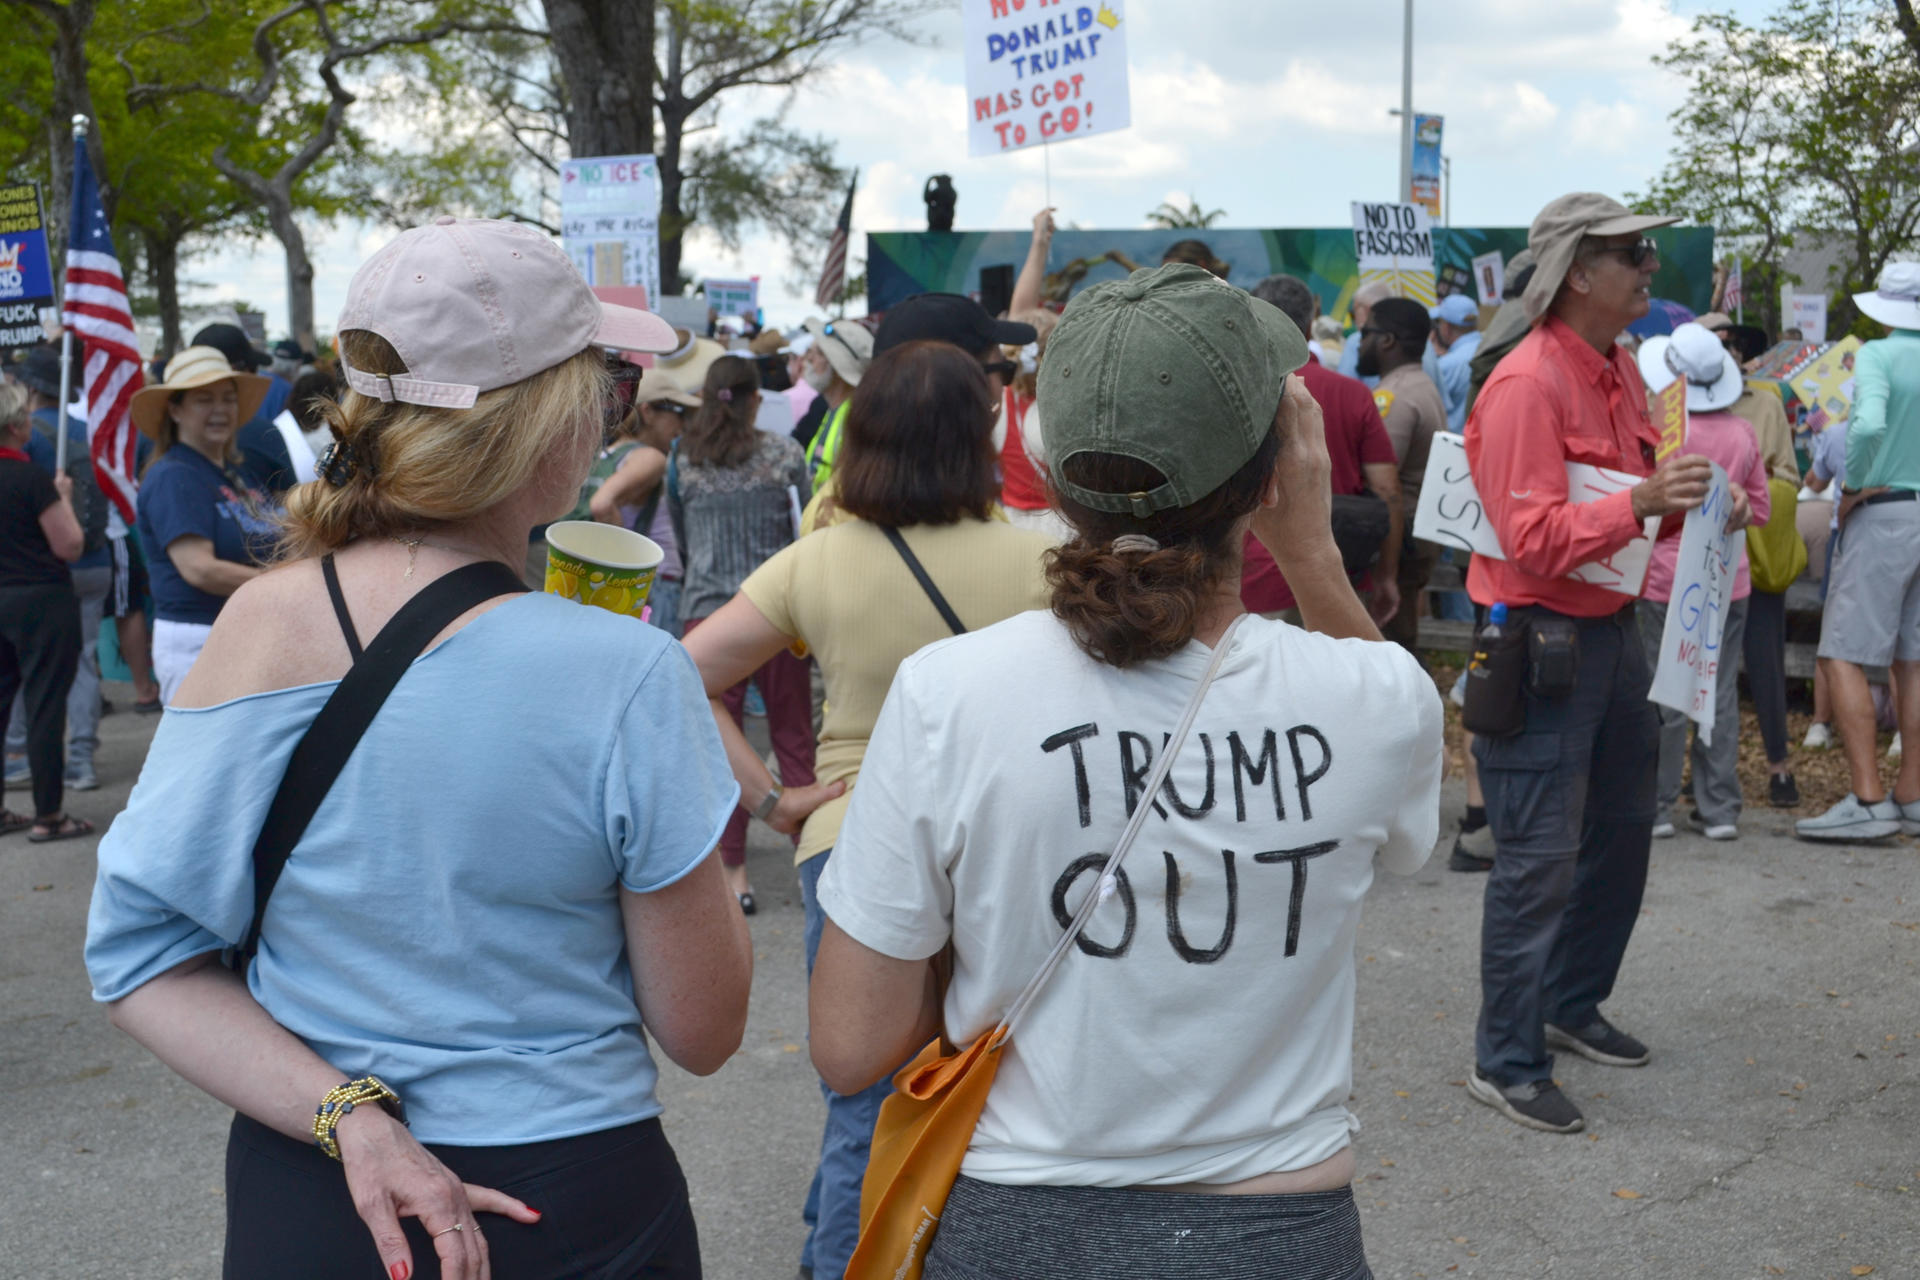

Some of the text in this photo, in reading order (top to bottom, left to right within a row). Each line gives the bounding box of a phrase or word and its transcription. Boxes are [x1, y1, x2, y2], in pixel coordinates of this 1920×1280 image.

[987, 7, 1093, 62] DONALD
[1011, 34, 1101, 80] TRUMP
[1031, 73, 1084, 108] GOT
[994, 102, 1093, 148] TO GO!
[580, 162, 640, 184] NO ICE
[0, 185, 36, 202] ONES
[0, 216, 41, 234] INGS
[1363, 203, 1416, 231] NO TO
[1355, 230, 1431, 257] FASCISM
[0, 326, 43, 346] RUMP
[1040, 721, 1332, 828] TRUMP
[1050, 838, 1343, 965] OUT
